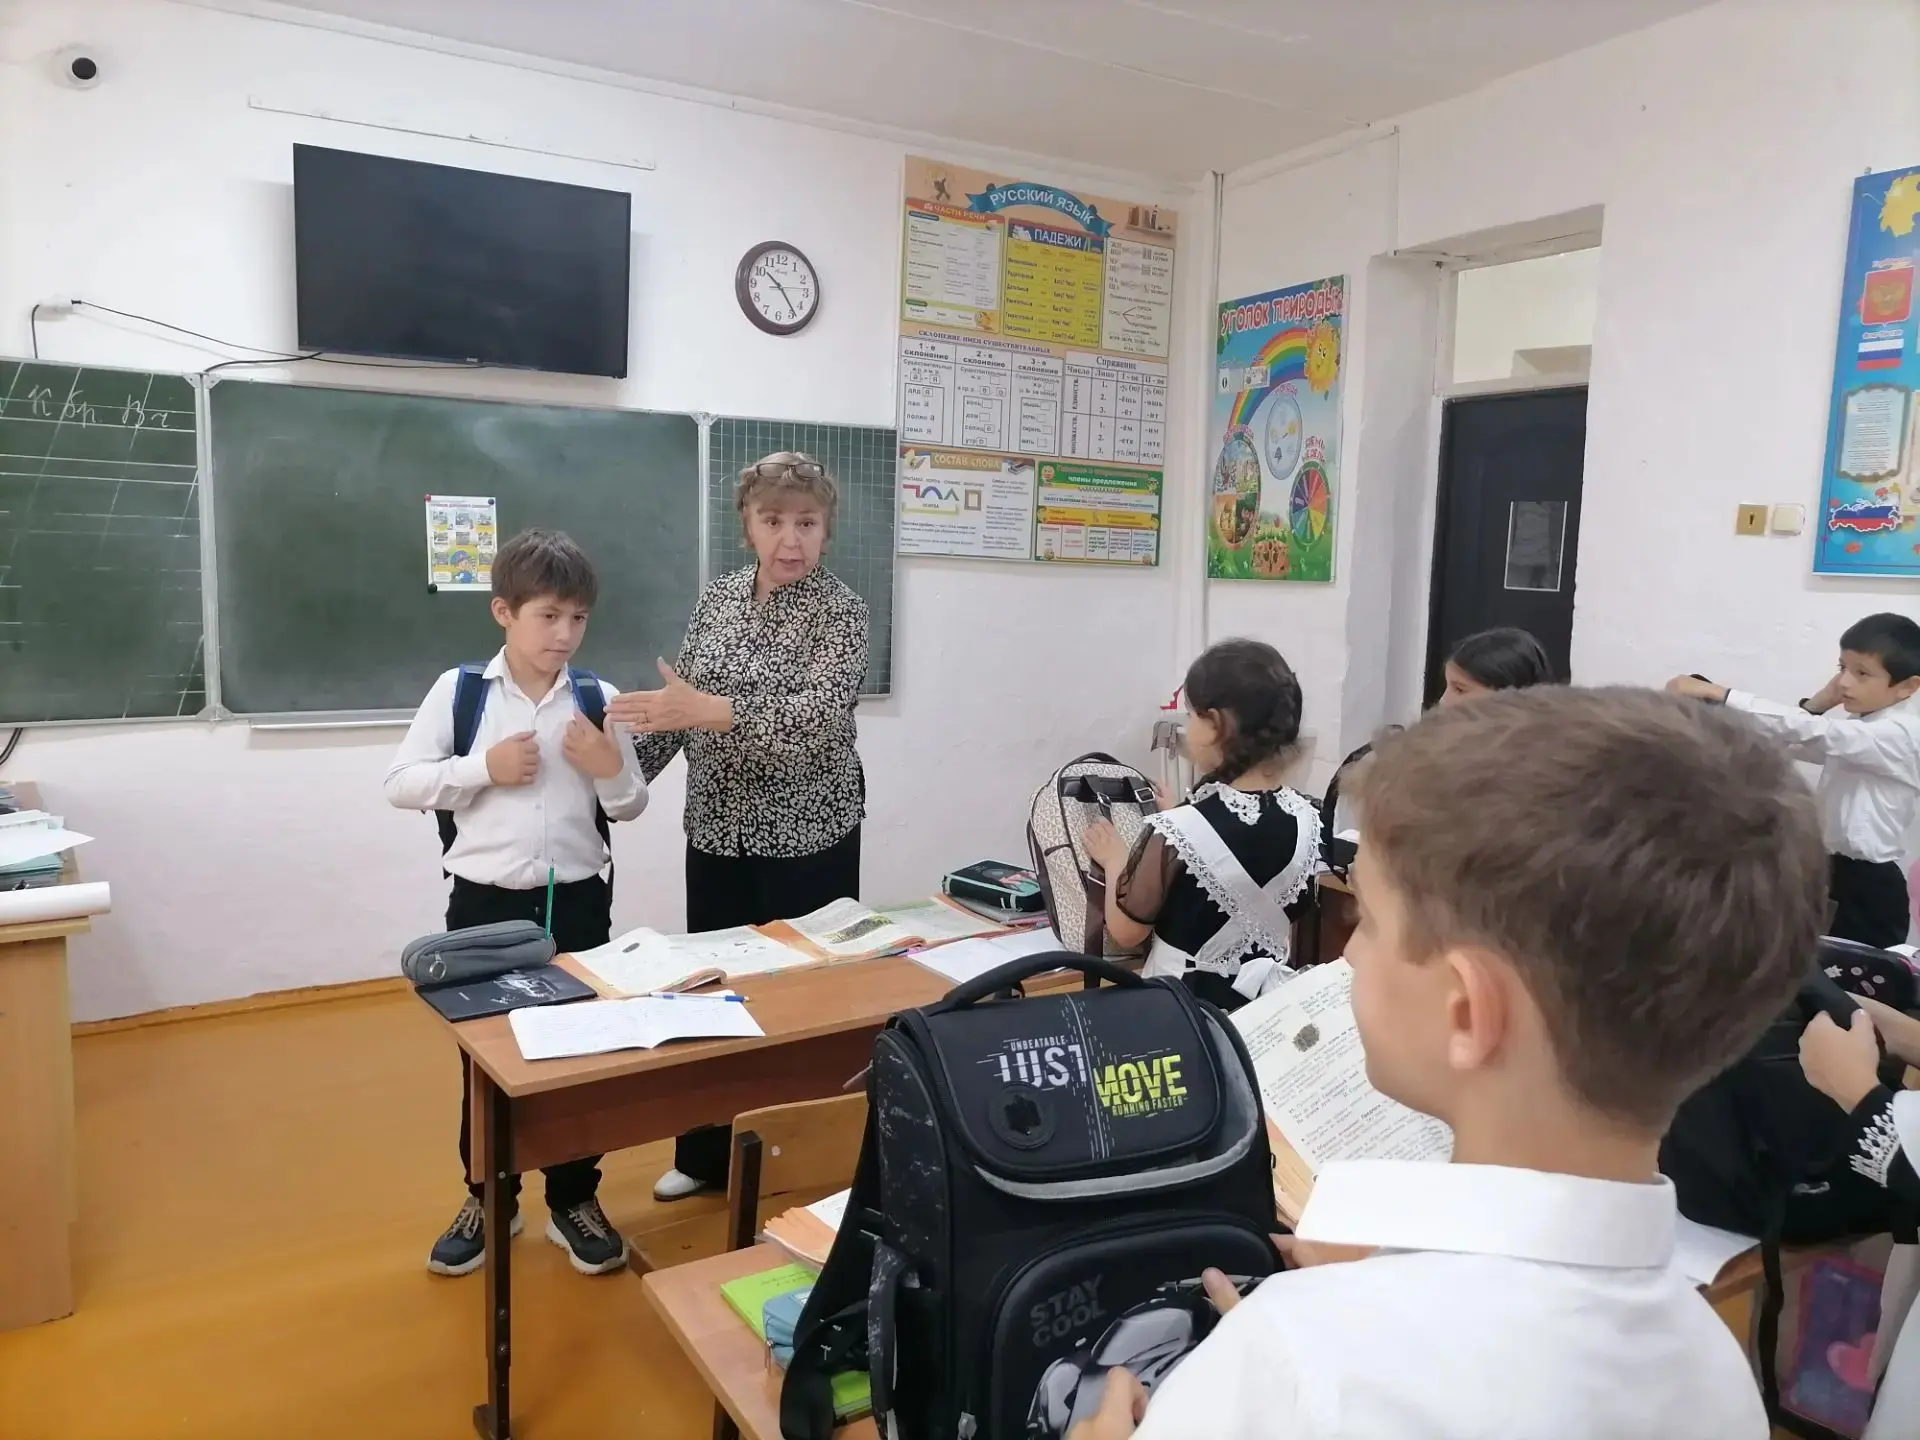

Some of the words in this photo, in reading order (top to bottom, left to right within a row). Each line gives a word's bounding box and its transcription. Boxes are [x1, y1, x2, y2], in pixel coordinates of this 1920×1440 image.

[989, 189, 1054, 206] РУССКИЙ
[1055, 196, 1095, 225] ЯЗЫК
[1034, 228, 1082, 248] ПАДЕЖИ
[765, 256, 775, 267] 11
[776, 254, 788, 265] 12
[755, 265, 766, 276] 10
[792, 262, 797, 272] 1
[750, 278, 757, 288] 9
[800, 274, 806, 285] 2
[753, 292, 760, 302] 8
[802, 288, 809, 298] 3
[763, 304, 770, 315] 7
[797, 301, 804, 310] 4
[775, 311, 782, 321] 6
[788, 309, 795, 319] 5
[1220, 301, 1270, 337] УГОЛОК
[1271, 287, 1343, 325] ПРИРОДЫ
[1067, 365, 1090, 375] Число
[934, 453, 968, 465] СОСТАВ
[1010, 1035, 1066, 1052] UNBEATABLE
[1111, 1099, 1150, 1116] RUNNING
[1151, 1096, 1185, 1111] FASTER
[1030, 1273, 1104, 1328] STAY
[1032, 1301, 1108, 1349] COOL
